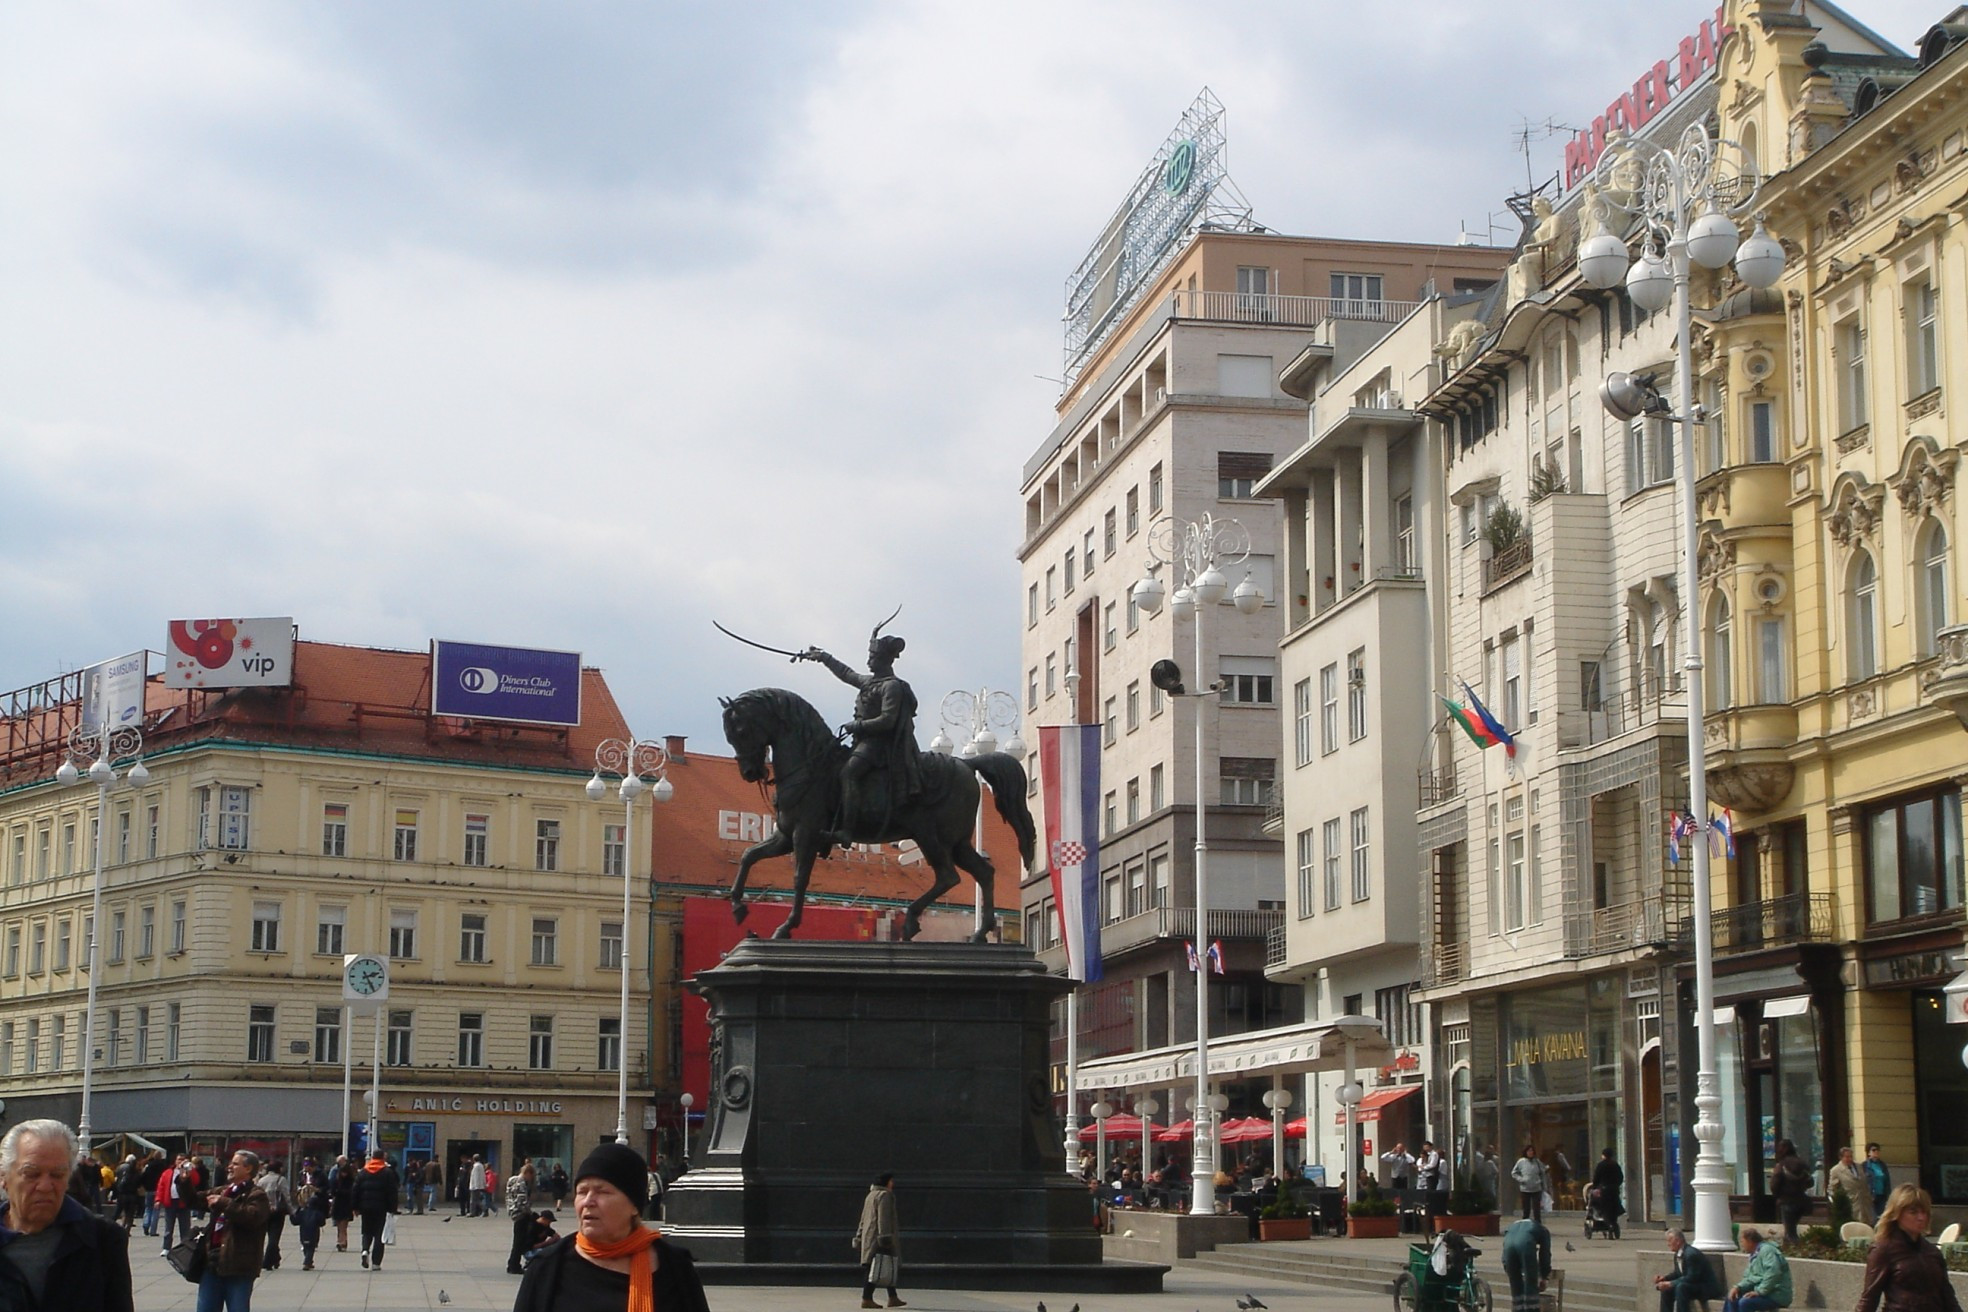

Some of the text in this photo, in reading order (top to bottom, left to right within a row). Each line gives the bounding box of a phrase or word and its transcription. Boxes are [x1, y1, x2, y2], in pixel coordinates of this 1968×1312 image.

[1565, 60, 1671, 193] PARTNER
[108, 660, 140, 679] SAMSUNG
[241, 653, 275, 677] vip
[500, 674, 551, 687] Diners Club
[500, 684, 555, 697] International
[718, 809, 779, 843] ERI
[1510, 1031, 1587, 1066] MALA KAVANA
[412, 1097, 562, 1113] ANIĆ HOLDING
